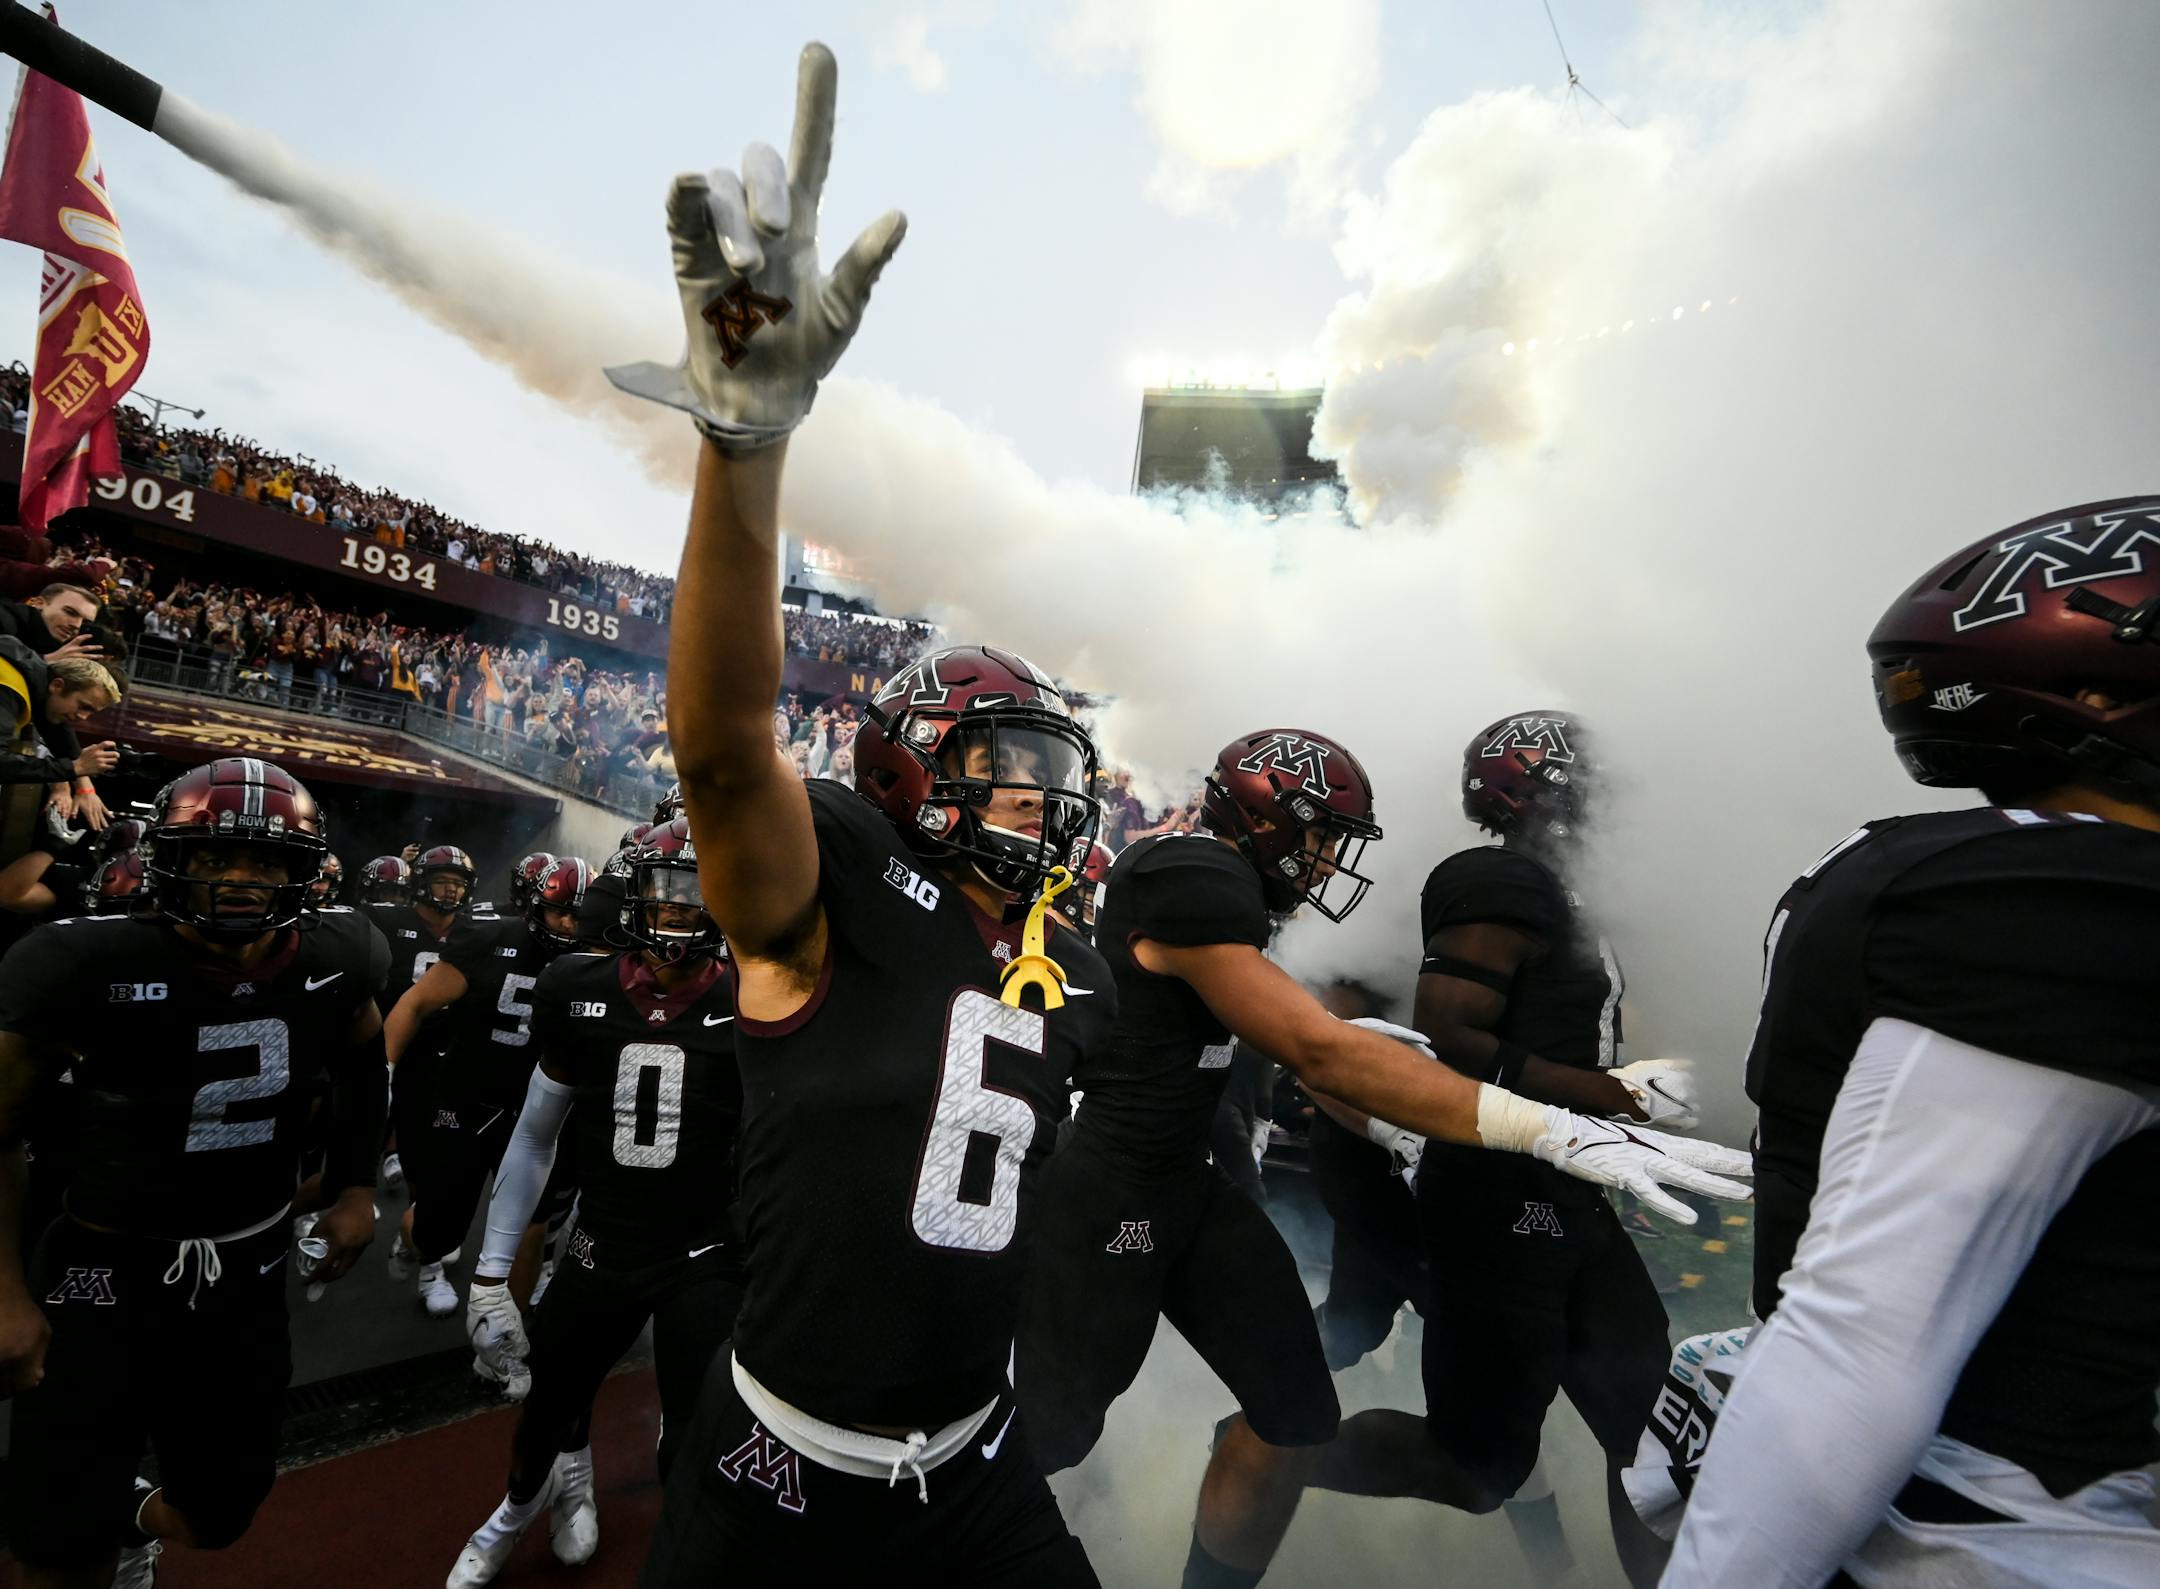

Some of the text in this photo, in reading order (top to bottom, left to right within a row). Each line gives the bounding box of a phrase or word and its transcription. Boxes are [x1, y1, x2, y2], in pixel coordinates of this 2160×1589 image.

[702, 277, 792, 370] M
[87, 472, 195, 522] 904
[340, 537, 437, 591] 1934
[546, 598, 619, 641] 1935
[1933, 682, 1974, 710] HERE
[1481, 718, 1575, 763] M
[1237, 734, 1331, 800] M
[238, 815, 266, 827] ROW
[491, 973, 537, 1047] 5
[185, 1017, 290, 1153] 2
[612, 1042, 686, 1170] 0
[908, 985, 1046, 1255] 6
[1106, 1221, 1154, 1255] M
[1513, 1201, 1564, 1238] M
[46, 1267, 117, 1306] M
[718, 1421, 807, 1513] M
